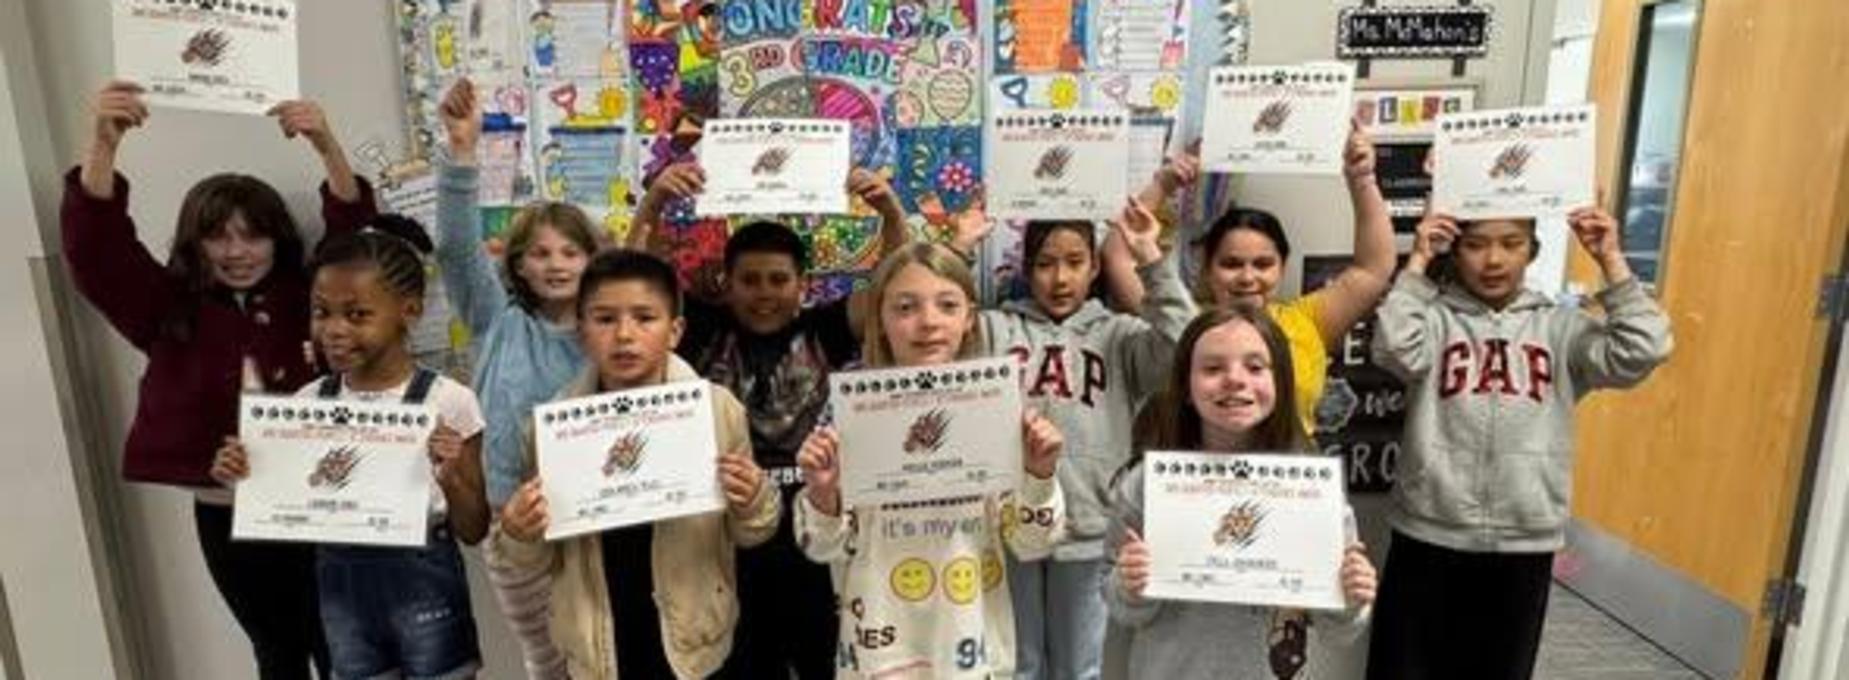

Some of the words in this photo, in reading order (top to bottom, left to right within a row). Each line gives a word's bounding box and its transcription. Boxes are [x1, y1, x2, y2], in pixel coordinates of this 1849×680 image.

[1384, 15, 1480, 42] McMahon's
[790, 38, 901, 84] GRADE
[1439, 338, 1553, 403] GAP
[922, 517, 957, 541] my
